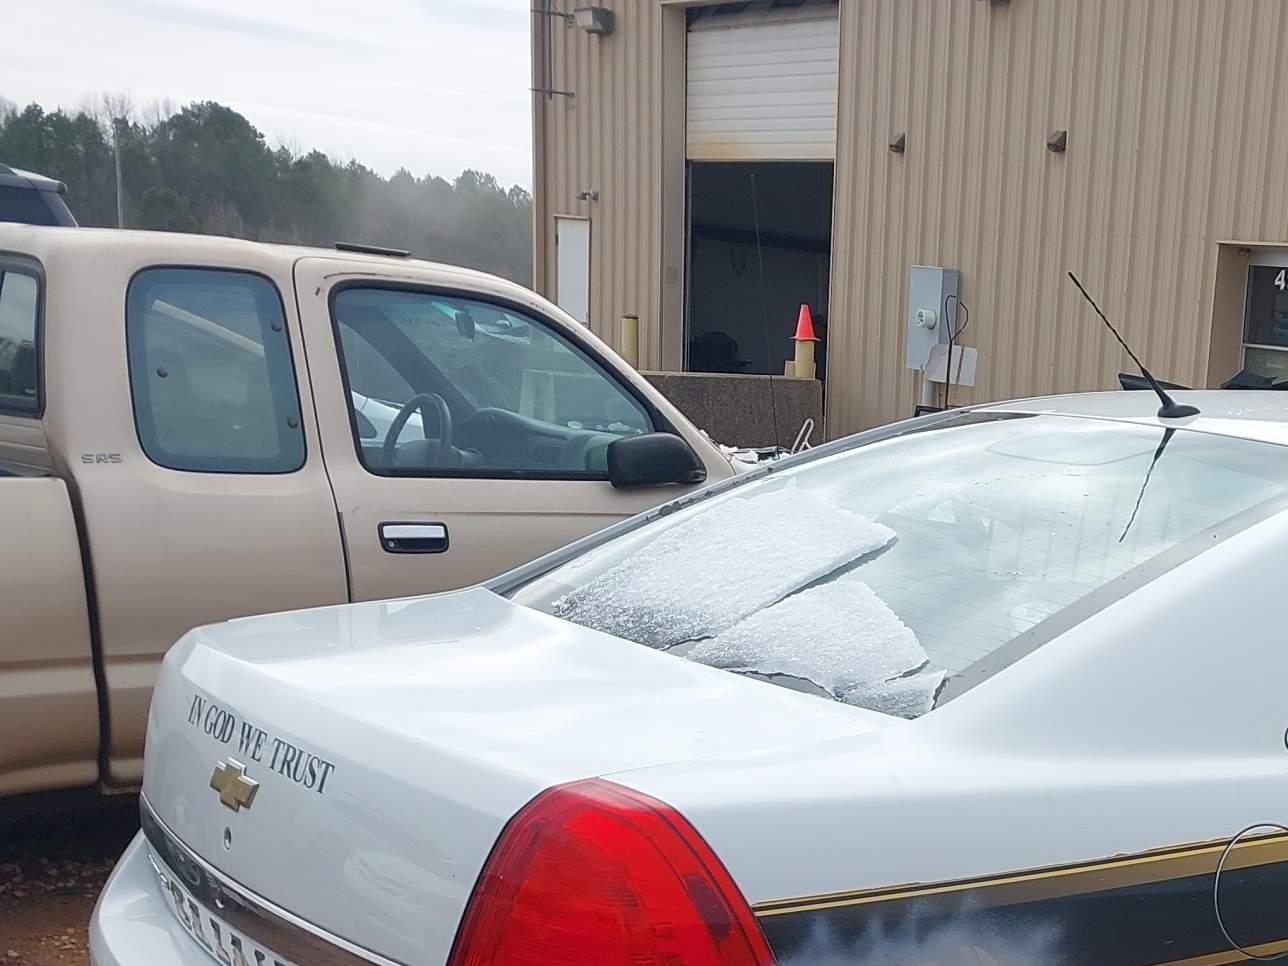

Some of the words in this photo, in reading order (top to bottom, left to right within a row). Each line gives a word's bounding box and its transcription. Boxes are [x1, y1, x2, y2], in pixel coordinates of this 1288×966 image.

[187, 694, 207, 728] IN
[204, 704, 236, 744] GOD
[238, 721, 268, 762] WE
[269, 737, 336, 795] TRUST
